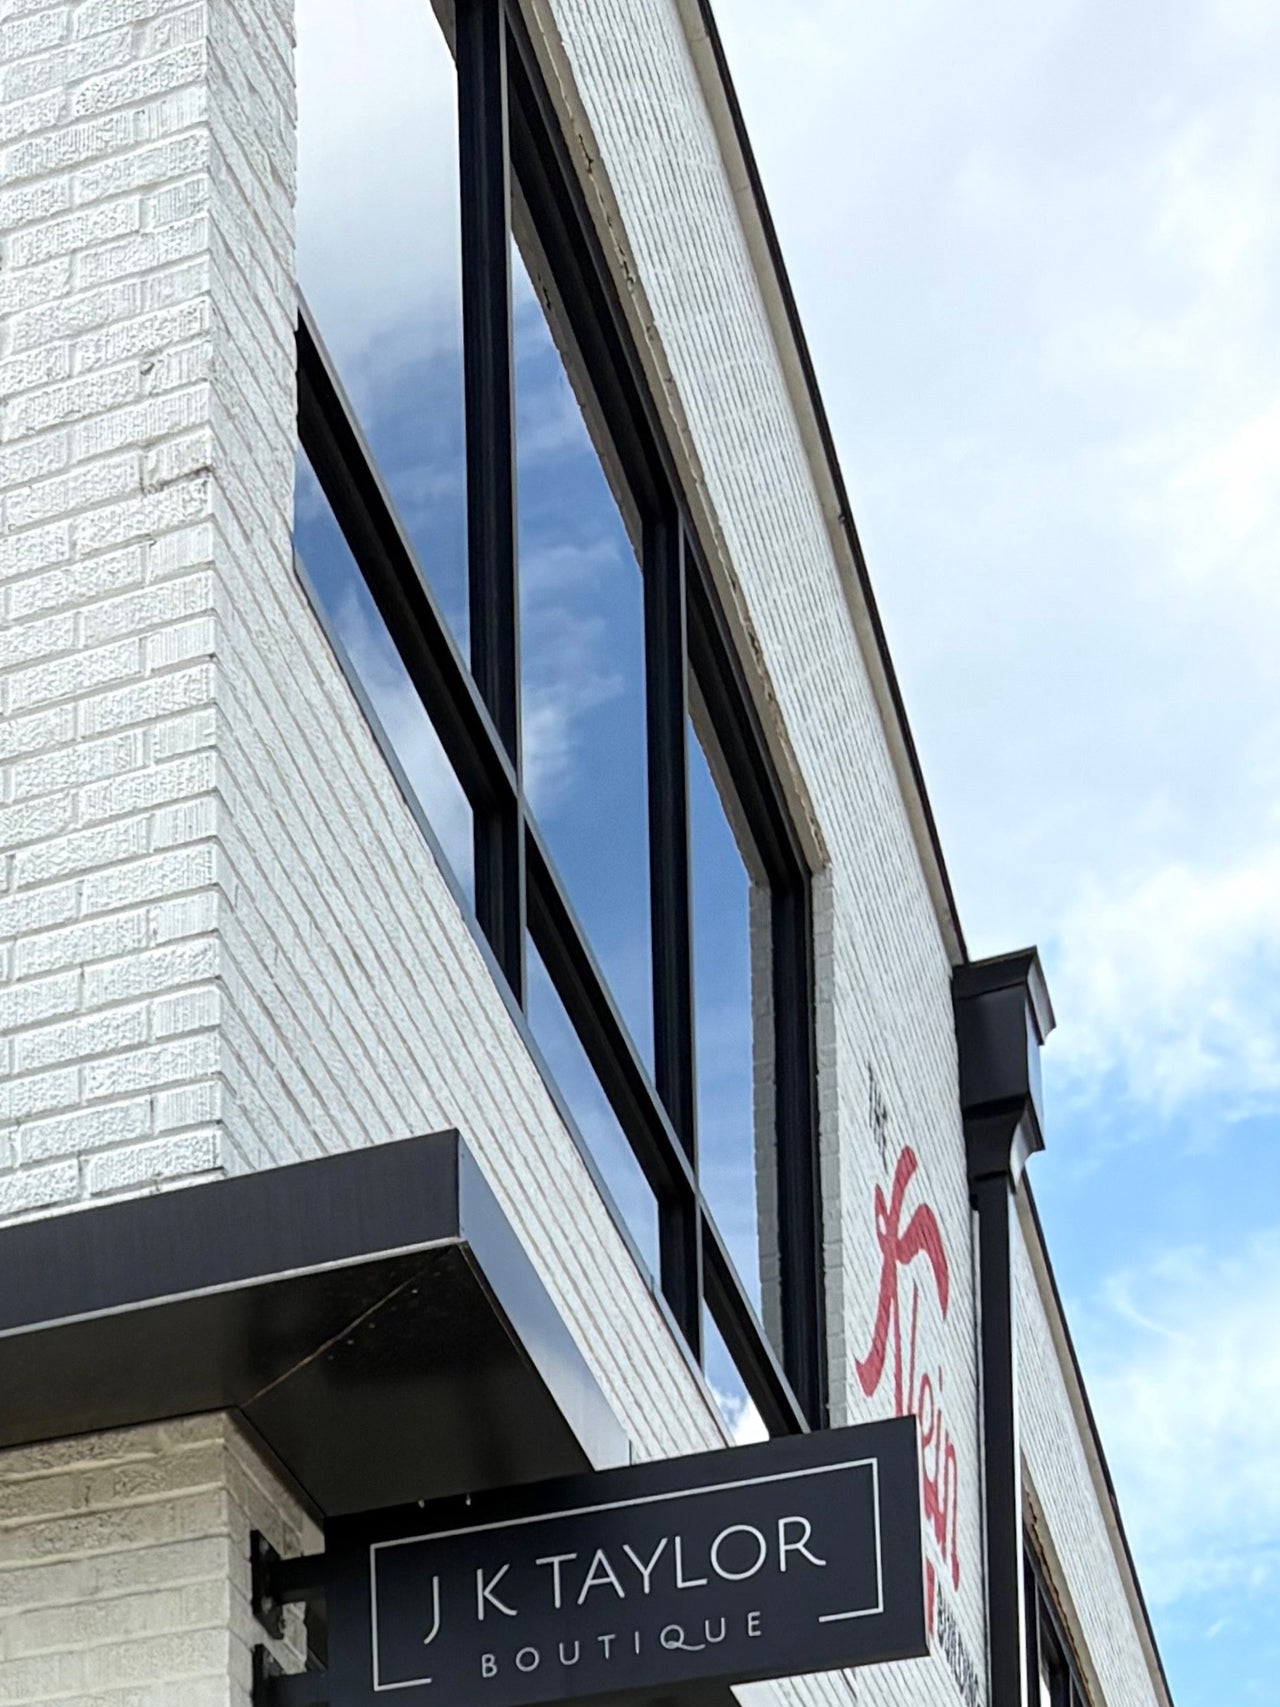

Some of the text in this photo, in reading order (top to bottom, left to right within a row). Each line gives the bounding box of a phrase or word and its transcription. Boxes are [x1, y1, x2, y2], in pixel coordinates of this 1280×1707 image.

[424, 1516, 827, 1644] J K TAYLOR
[480, 1611, 762, 1678] BOUTIQUE
